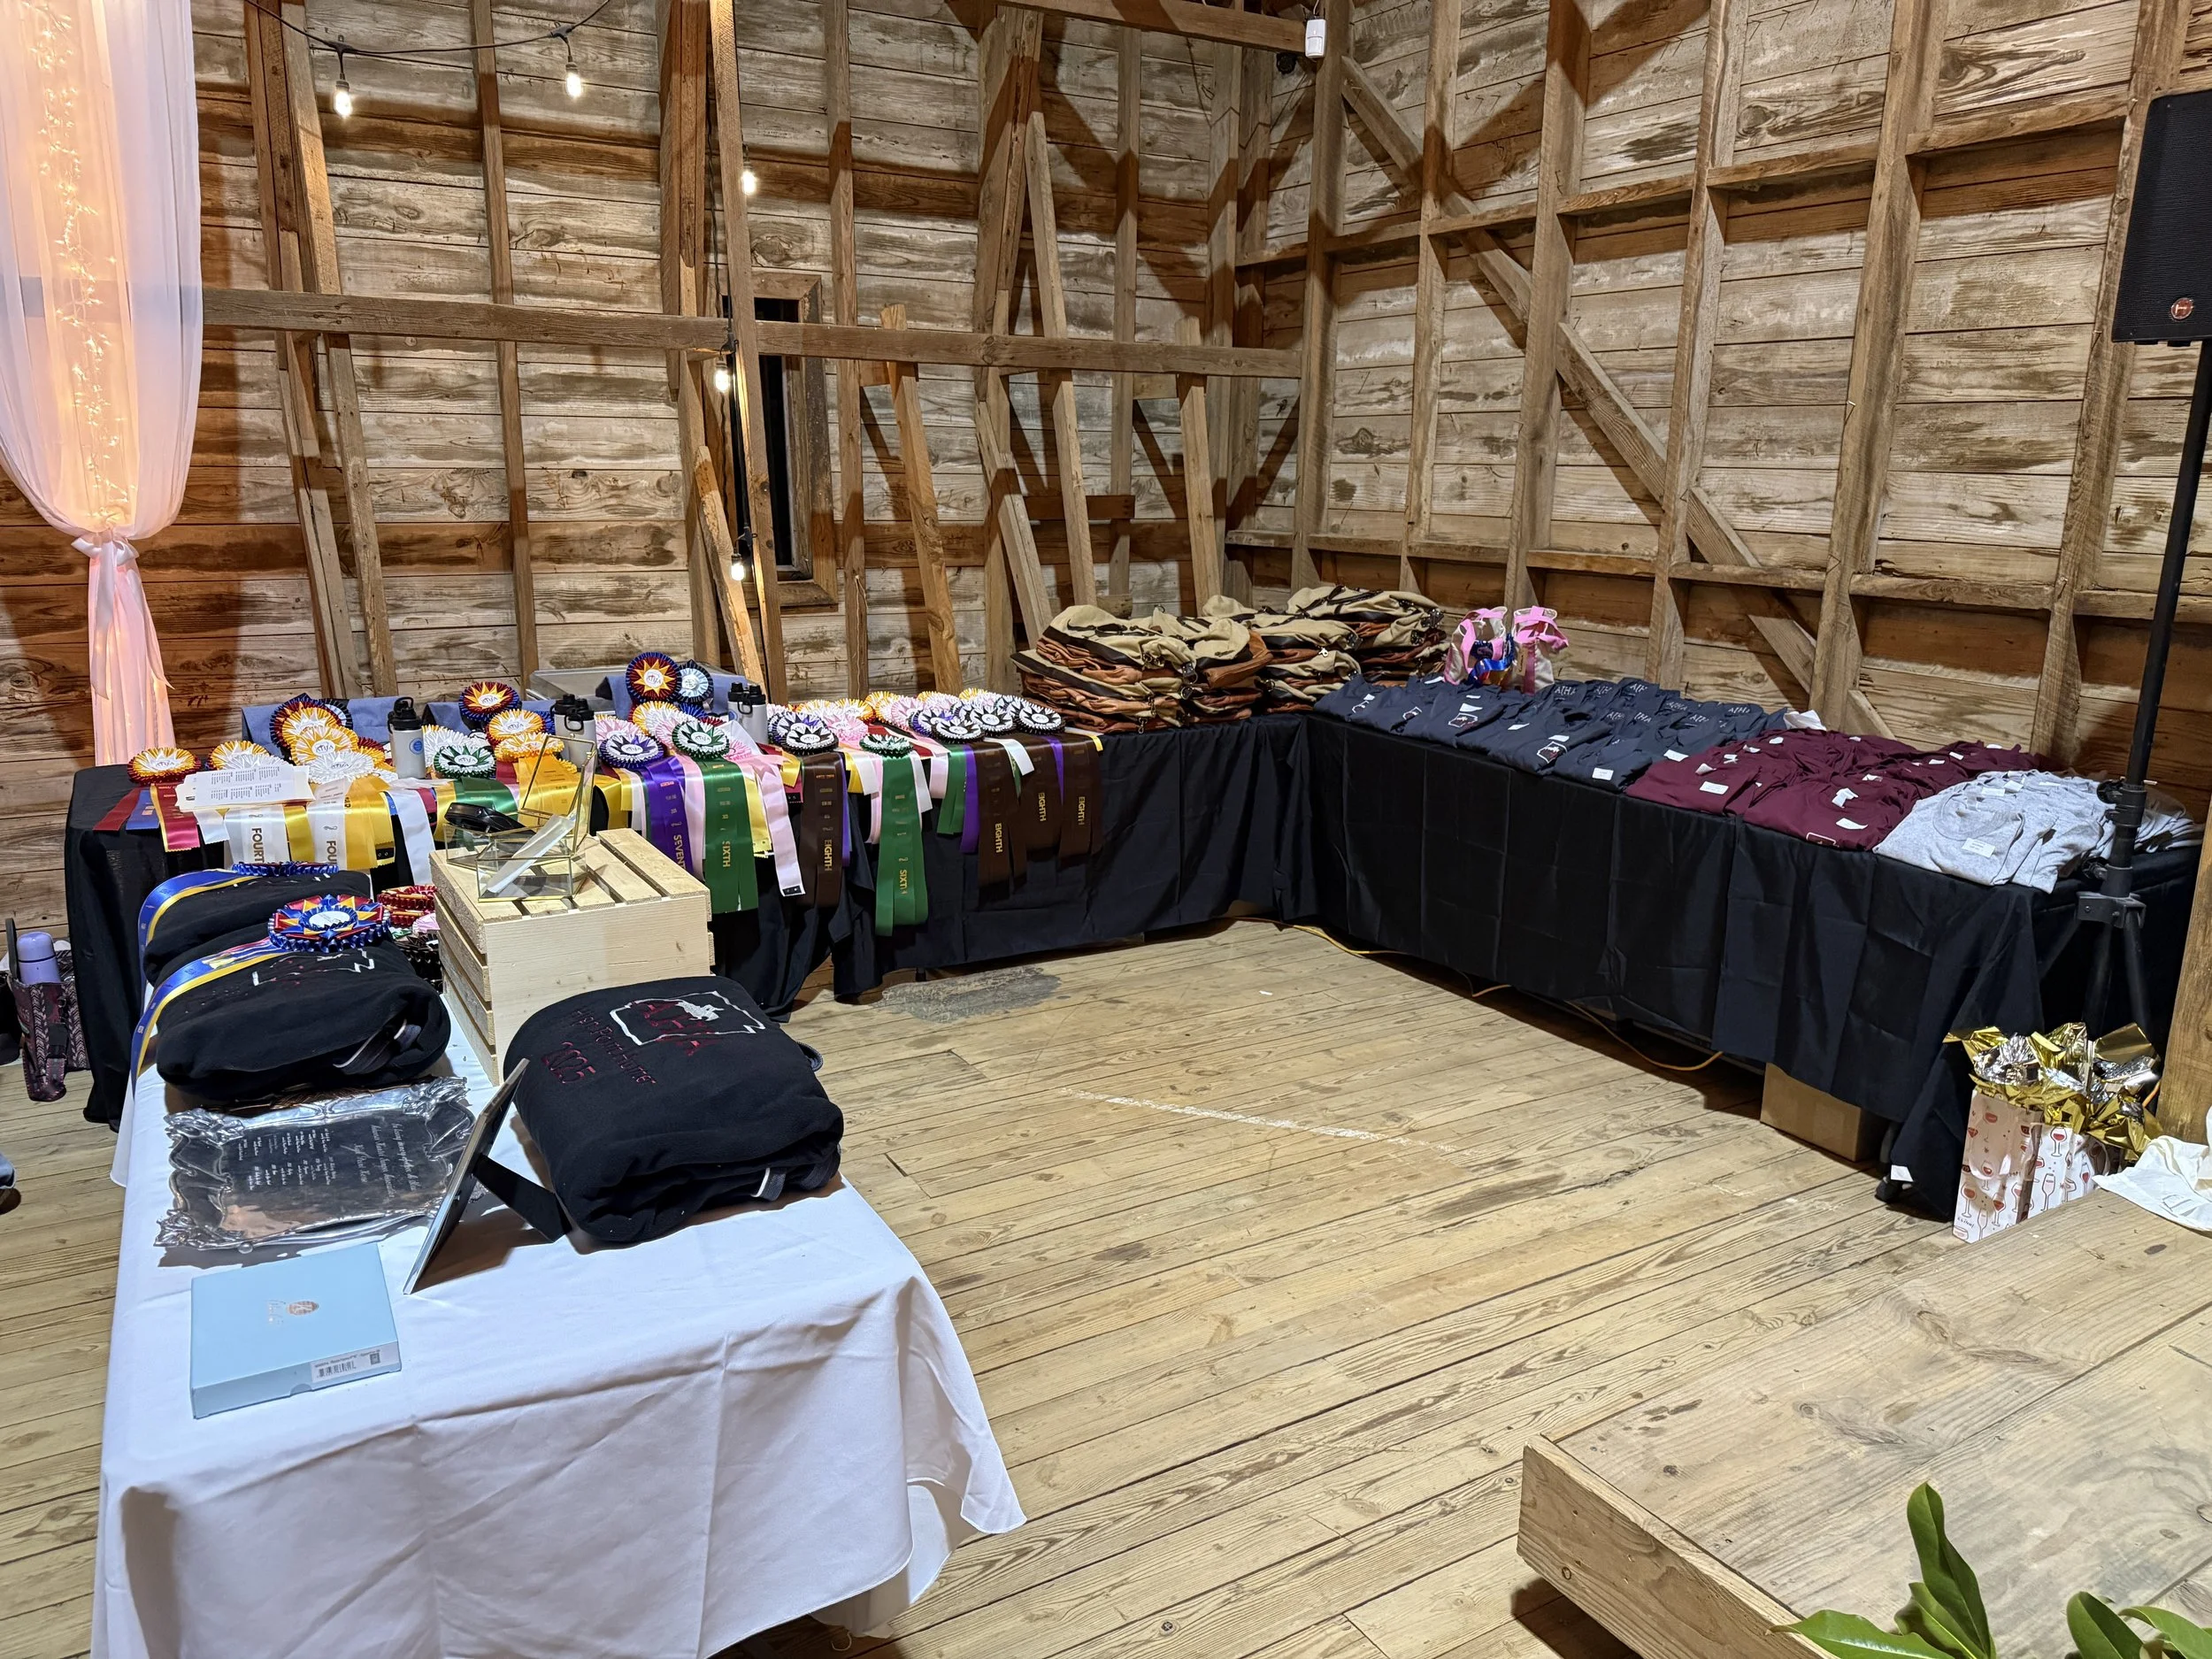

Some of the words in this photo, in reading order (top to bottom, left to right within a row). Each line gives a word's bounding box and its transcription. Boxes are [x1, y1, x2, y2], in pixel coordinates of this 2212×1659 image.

[1039, 792, 1048, 822] EIGHTH
[1078, 795, 1087, 826] EIGHTH
[251, 827, 265, 864] FOURT
[326, 840, 338, 865] FOU
[673, 834, 687, 870] SEVENT
[722, 840, 732, 867] SIXTH
[995, 822, 1003, 854] EIGHTH
[824, 839, 833, 872] EIGHTH
